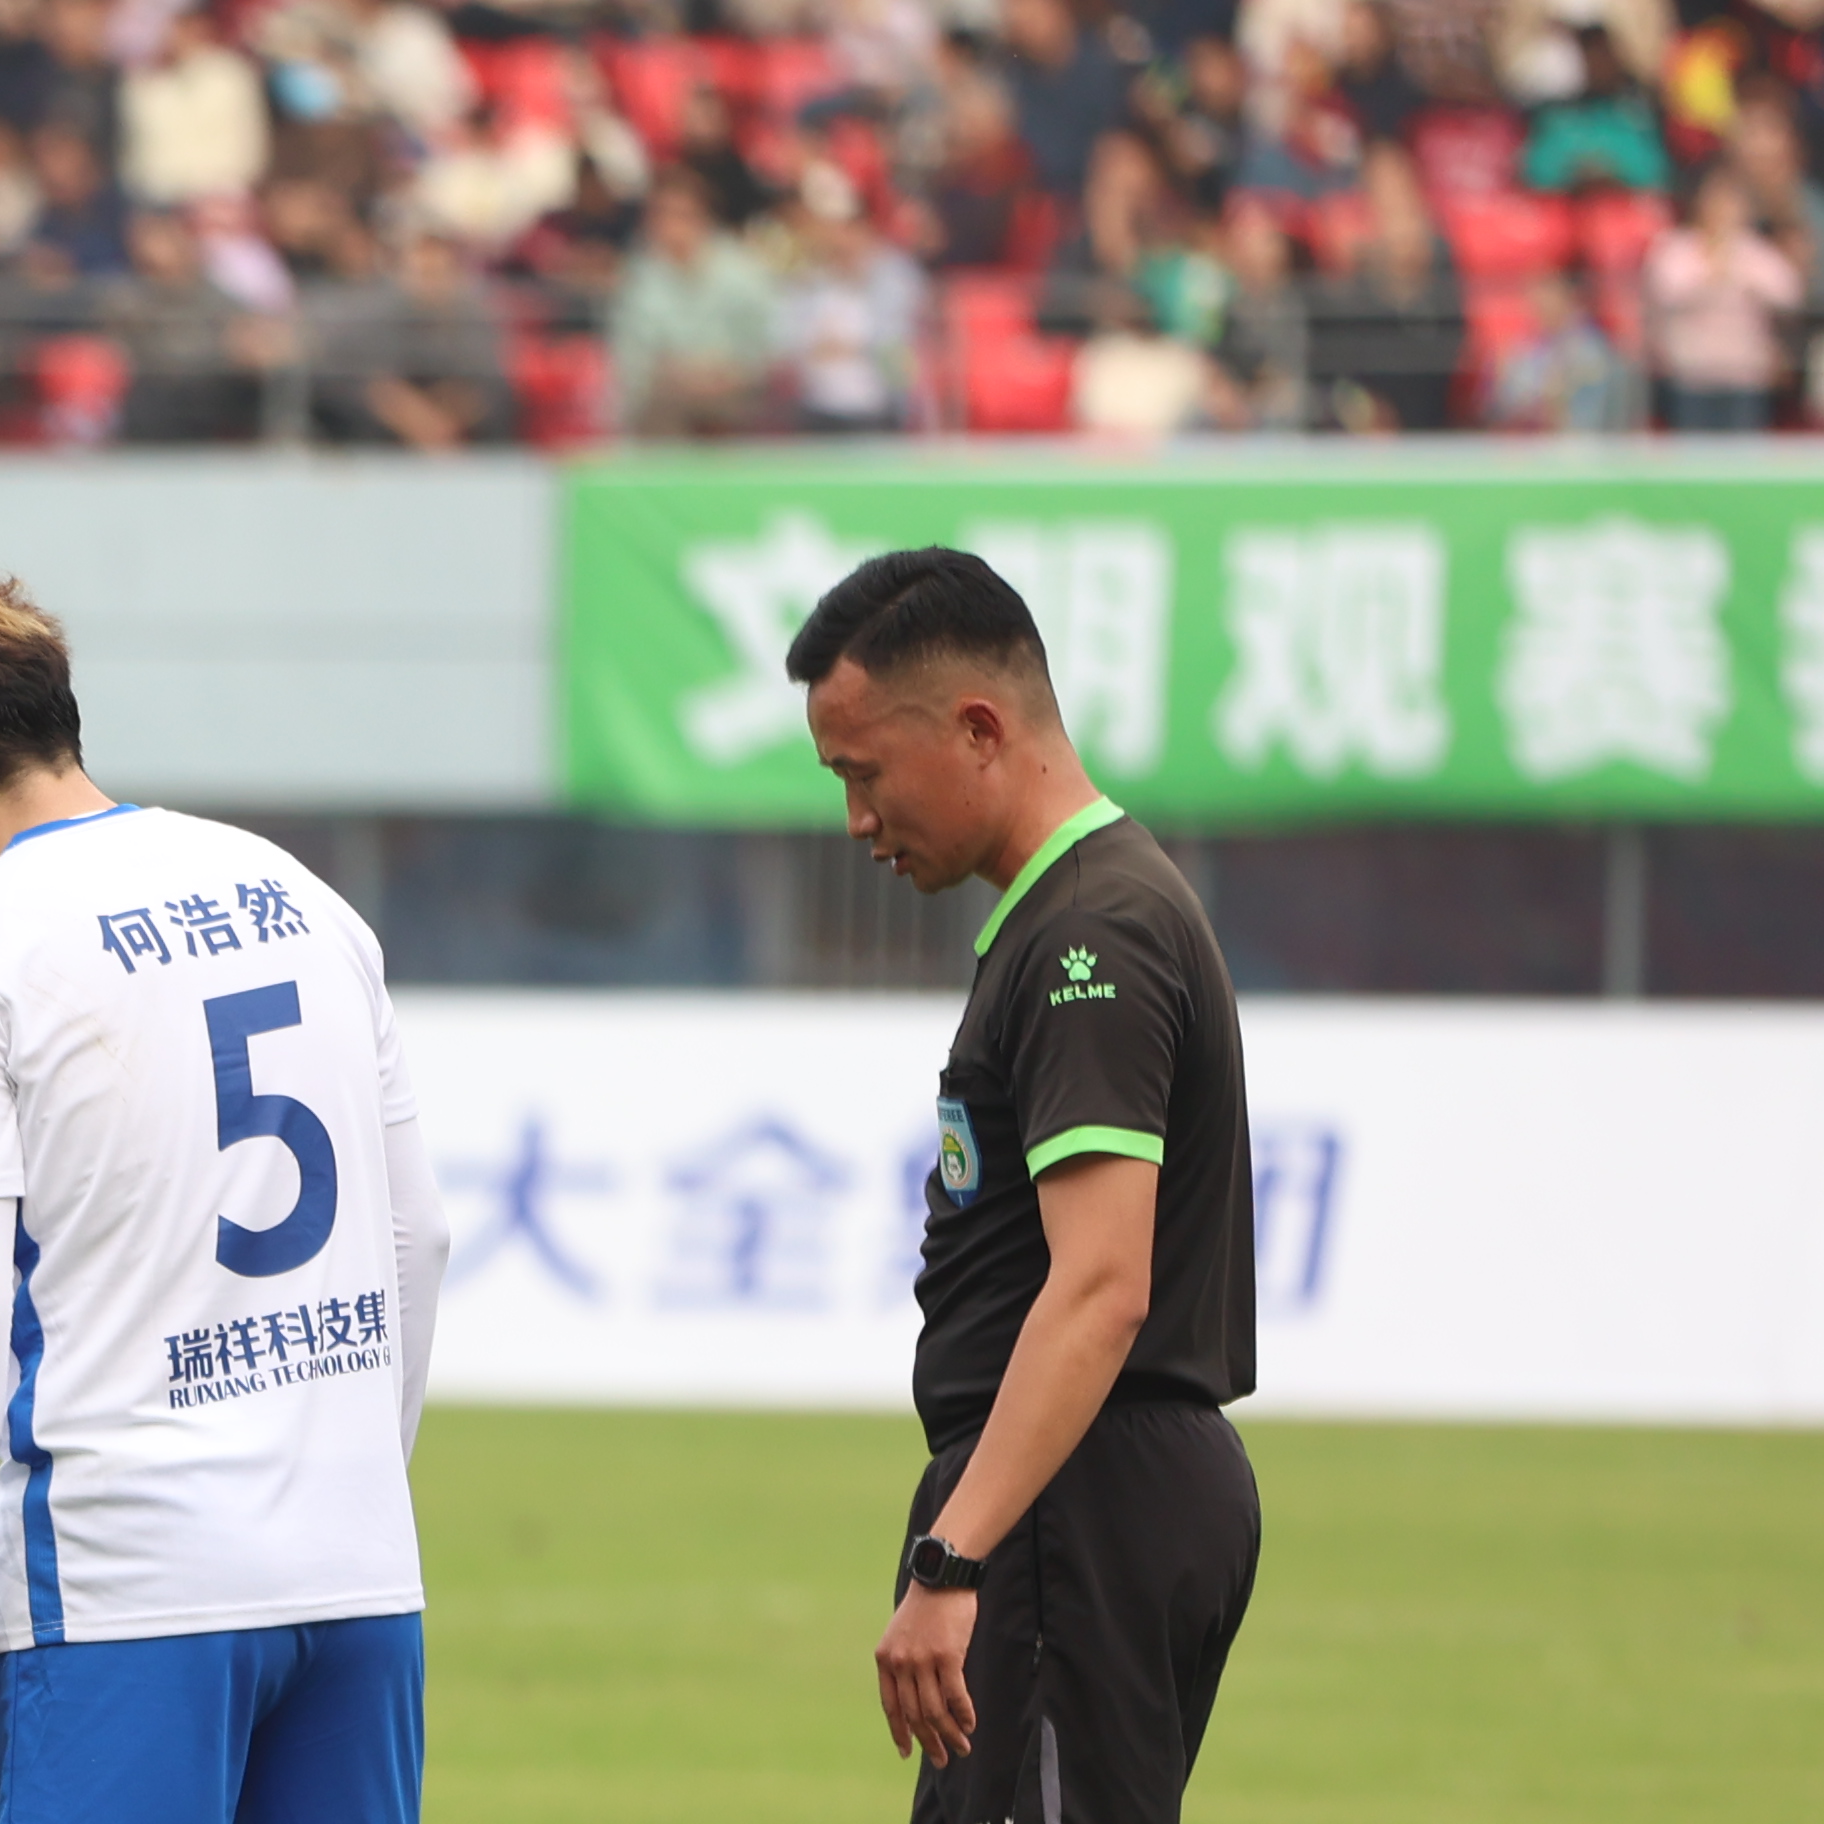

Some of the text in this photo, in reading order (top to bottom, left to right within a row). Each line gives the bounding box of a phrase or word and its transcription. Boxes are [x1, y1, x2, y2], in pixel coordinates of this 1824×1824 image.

[96, 878, 310, 974] 何浩然
[1049, 983, 1116, 1006] KELME
[202, 980, 337, 1277] 5
[169, 1372, 267, 1409] RUIXIANG
